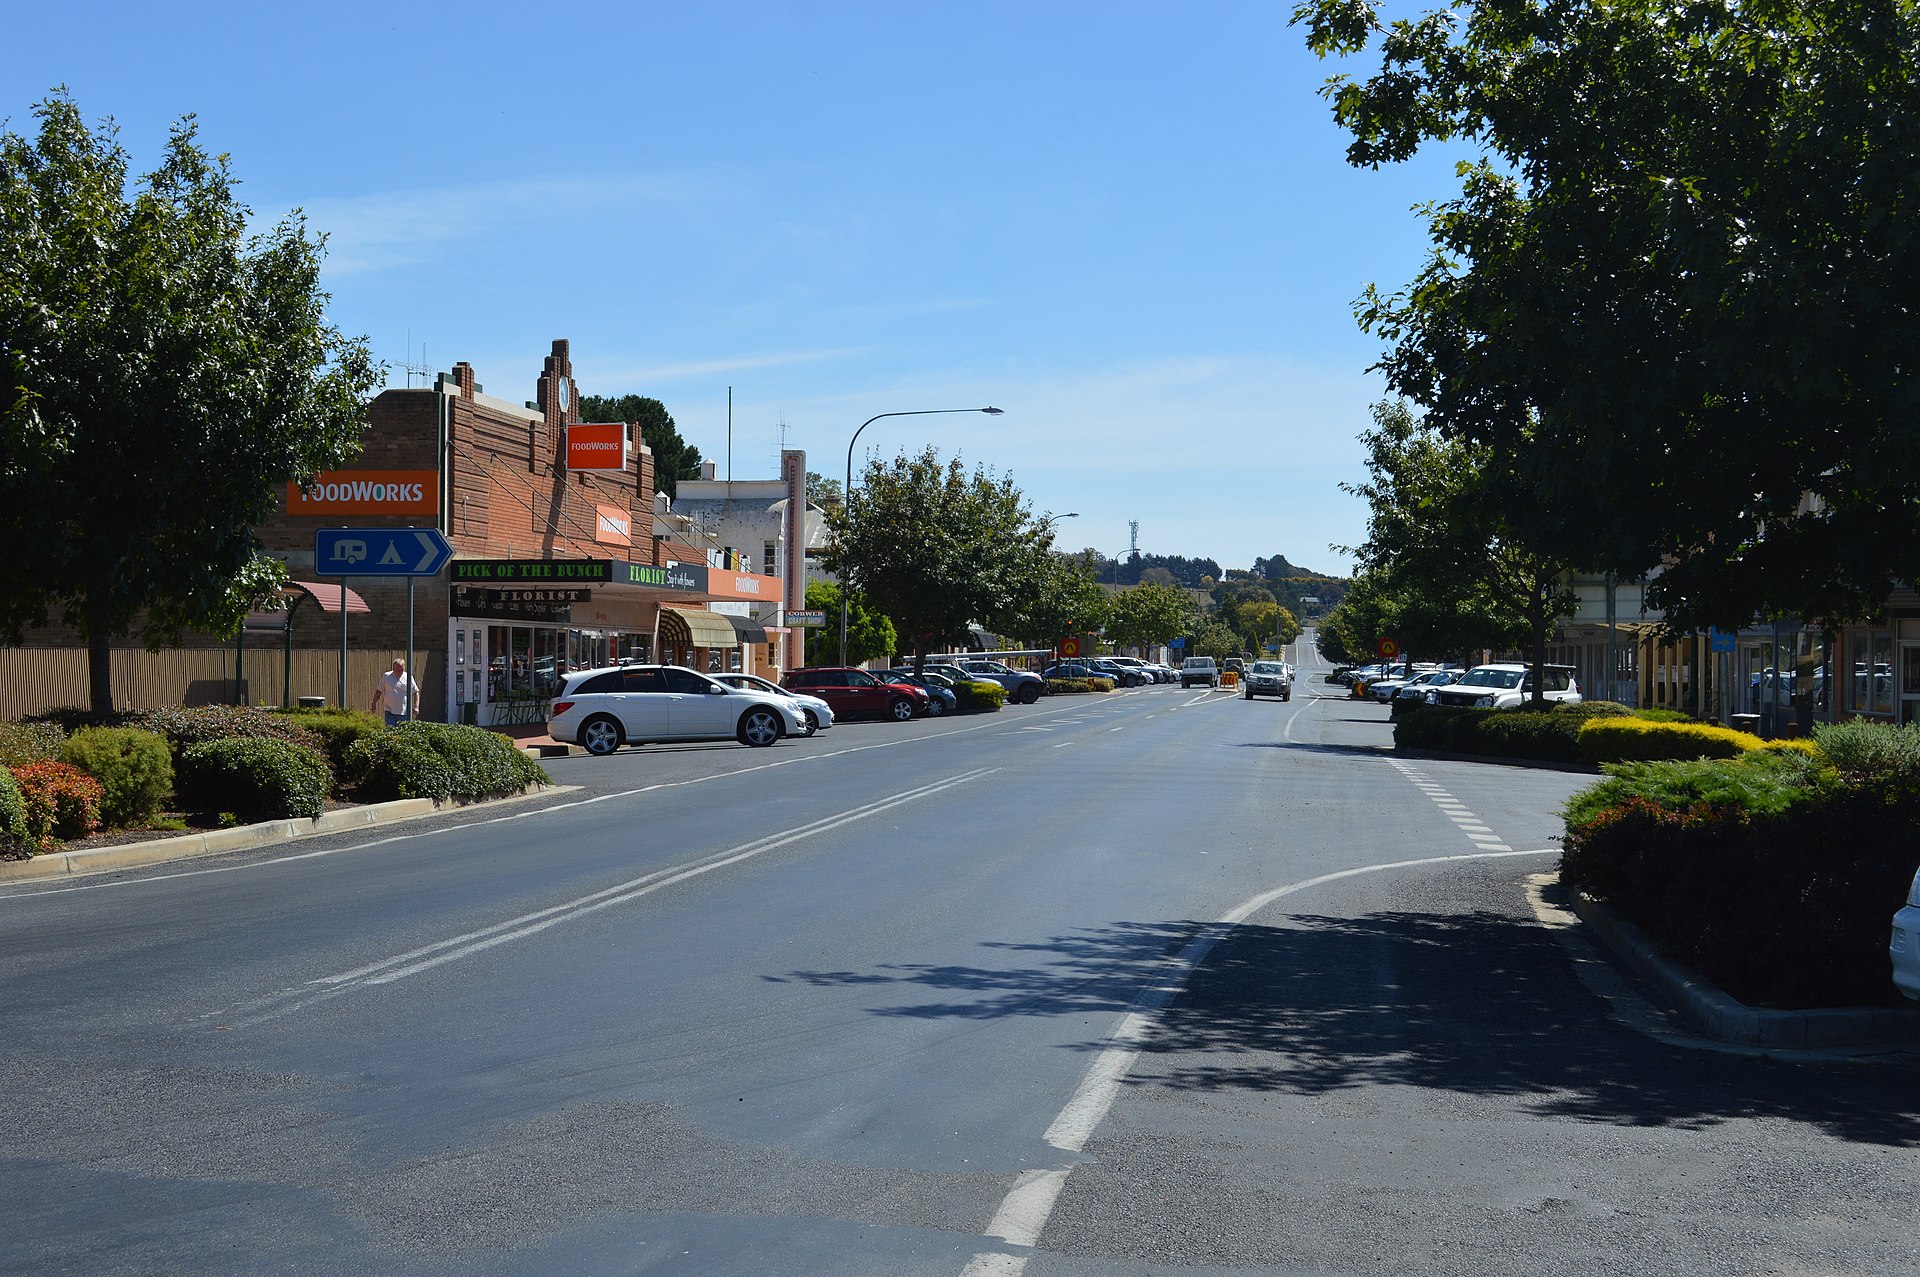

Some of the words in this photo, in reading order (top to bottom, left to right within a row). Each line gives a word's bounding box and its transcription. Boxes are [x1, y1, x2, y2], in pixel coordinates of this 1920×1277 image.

[571, 441, 619, 451] FOODWORKS
[302, 481, 423, 502] OODWORKS
[458, 564, 492, 577] PICK
[497, 564, 515, 577] OF
[519, 564, 552, 577] THE
[556, 564, 604, 577] BUNCH
[629, 565, 666, 585] FLORIST
[735, 576, 760, 595] FOODWORKS
[500, 591, 579, 601] FLORIST
[807, 617, 822, 625] SHOP
